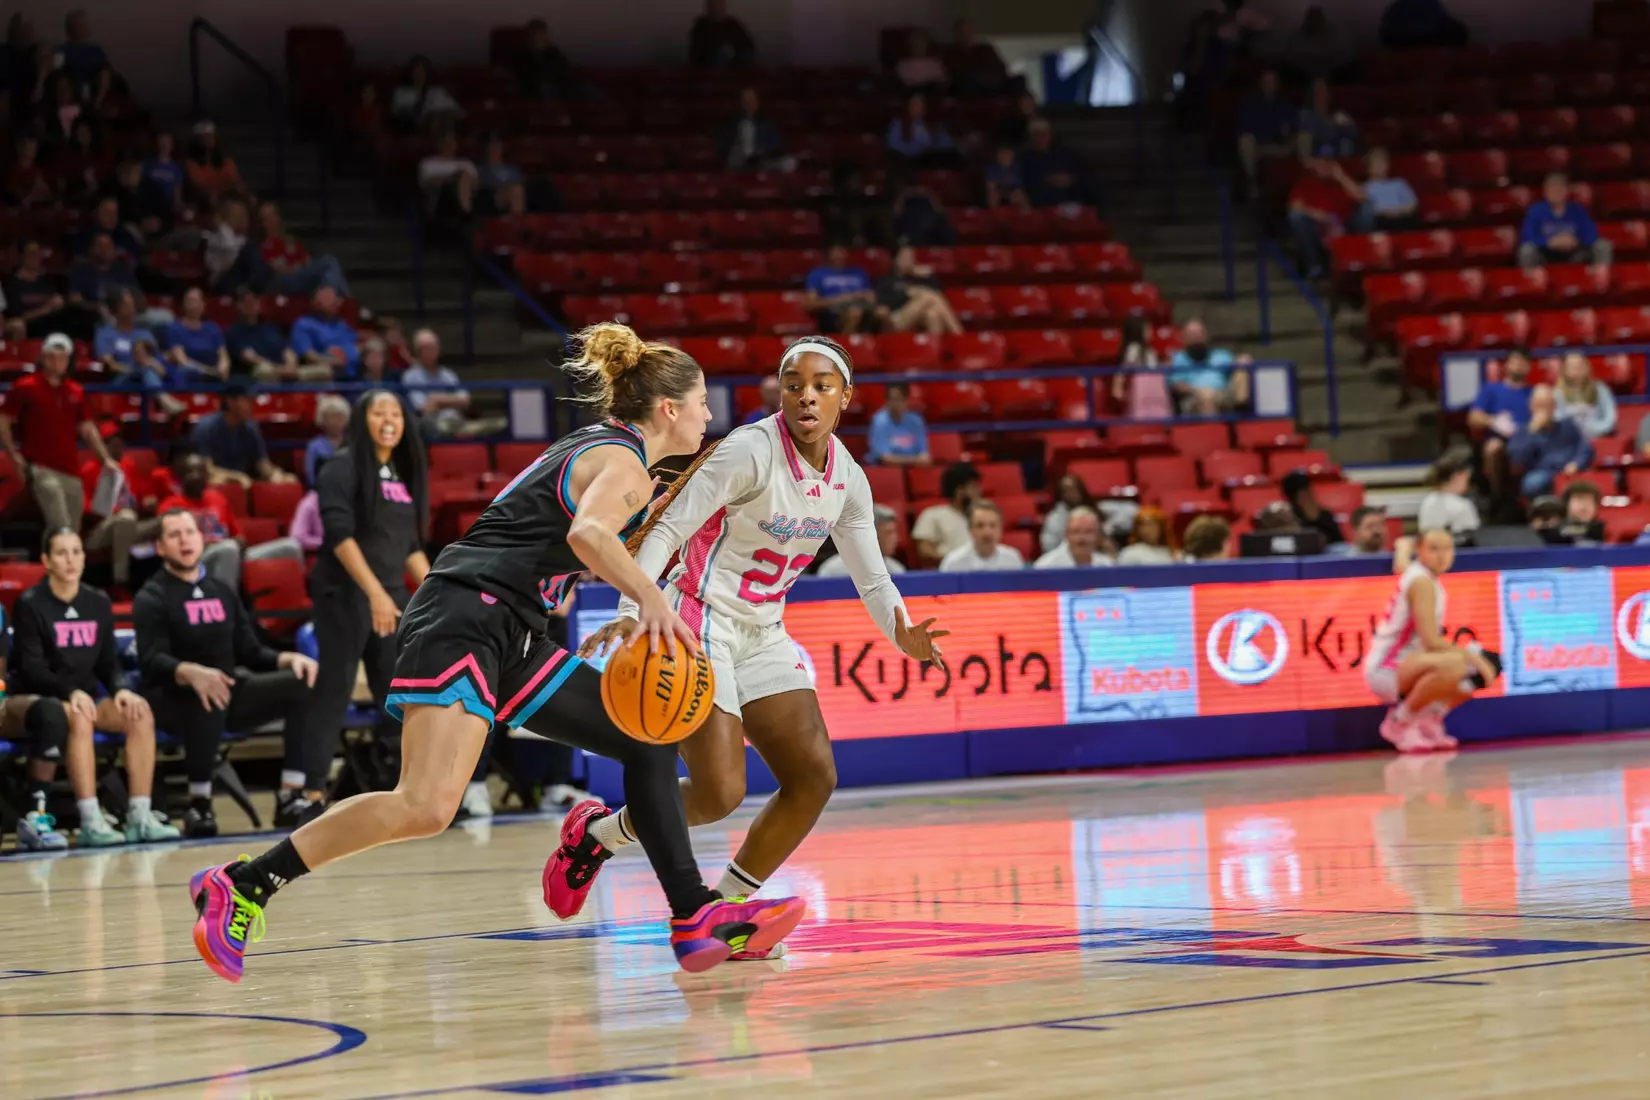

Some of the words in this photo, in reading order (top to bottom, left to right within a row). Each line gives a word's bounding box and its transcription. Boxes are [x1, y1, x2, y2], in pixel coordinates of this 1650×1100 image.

[758, 512, 798, 545] Lady
[184, 598, 227, 625] FIU
[53, 620, 98, 647] FIU
[682, 649, 709, 724] Wilson
[1091, 665, 1191, 695] Kubota
